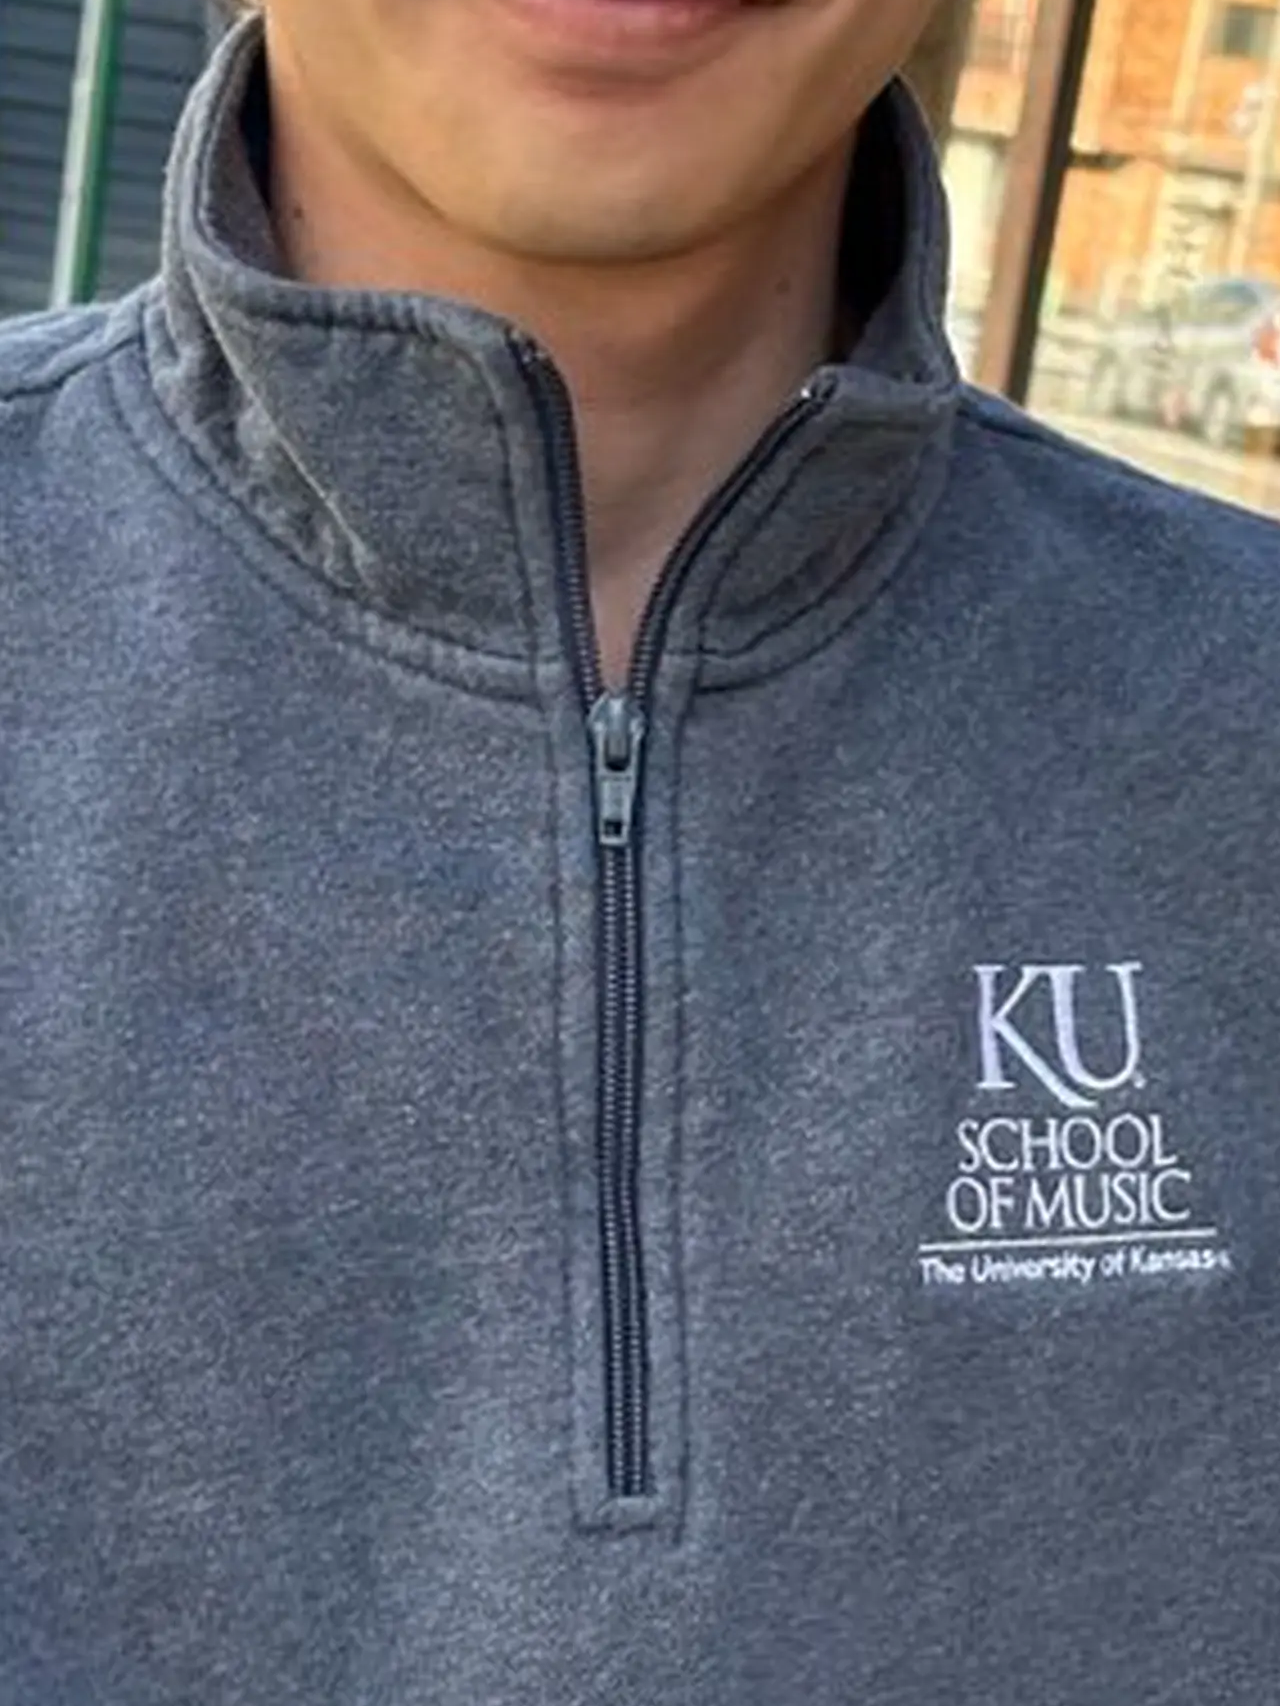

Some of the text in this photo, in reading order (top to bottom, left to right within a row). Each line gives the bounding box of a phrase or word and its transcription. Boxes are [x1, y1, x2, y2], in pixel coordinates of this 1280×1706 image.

[973, 961, 1144, 1109] KU
[956, 1113, 1178, 1173] SCHOOL
[946, 1168, 1192, 1232] OF MUSIC
[919, 1256, 966, 1285] The
[971, 1250, 1096, 1286] University
[1100, 1246, 1127, 1277] of
